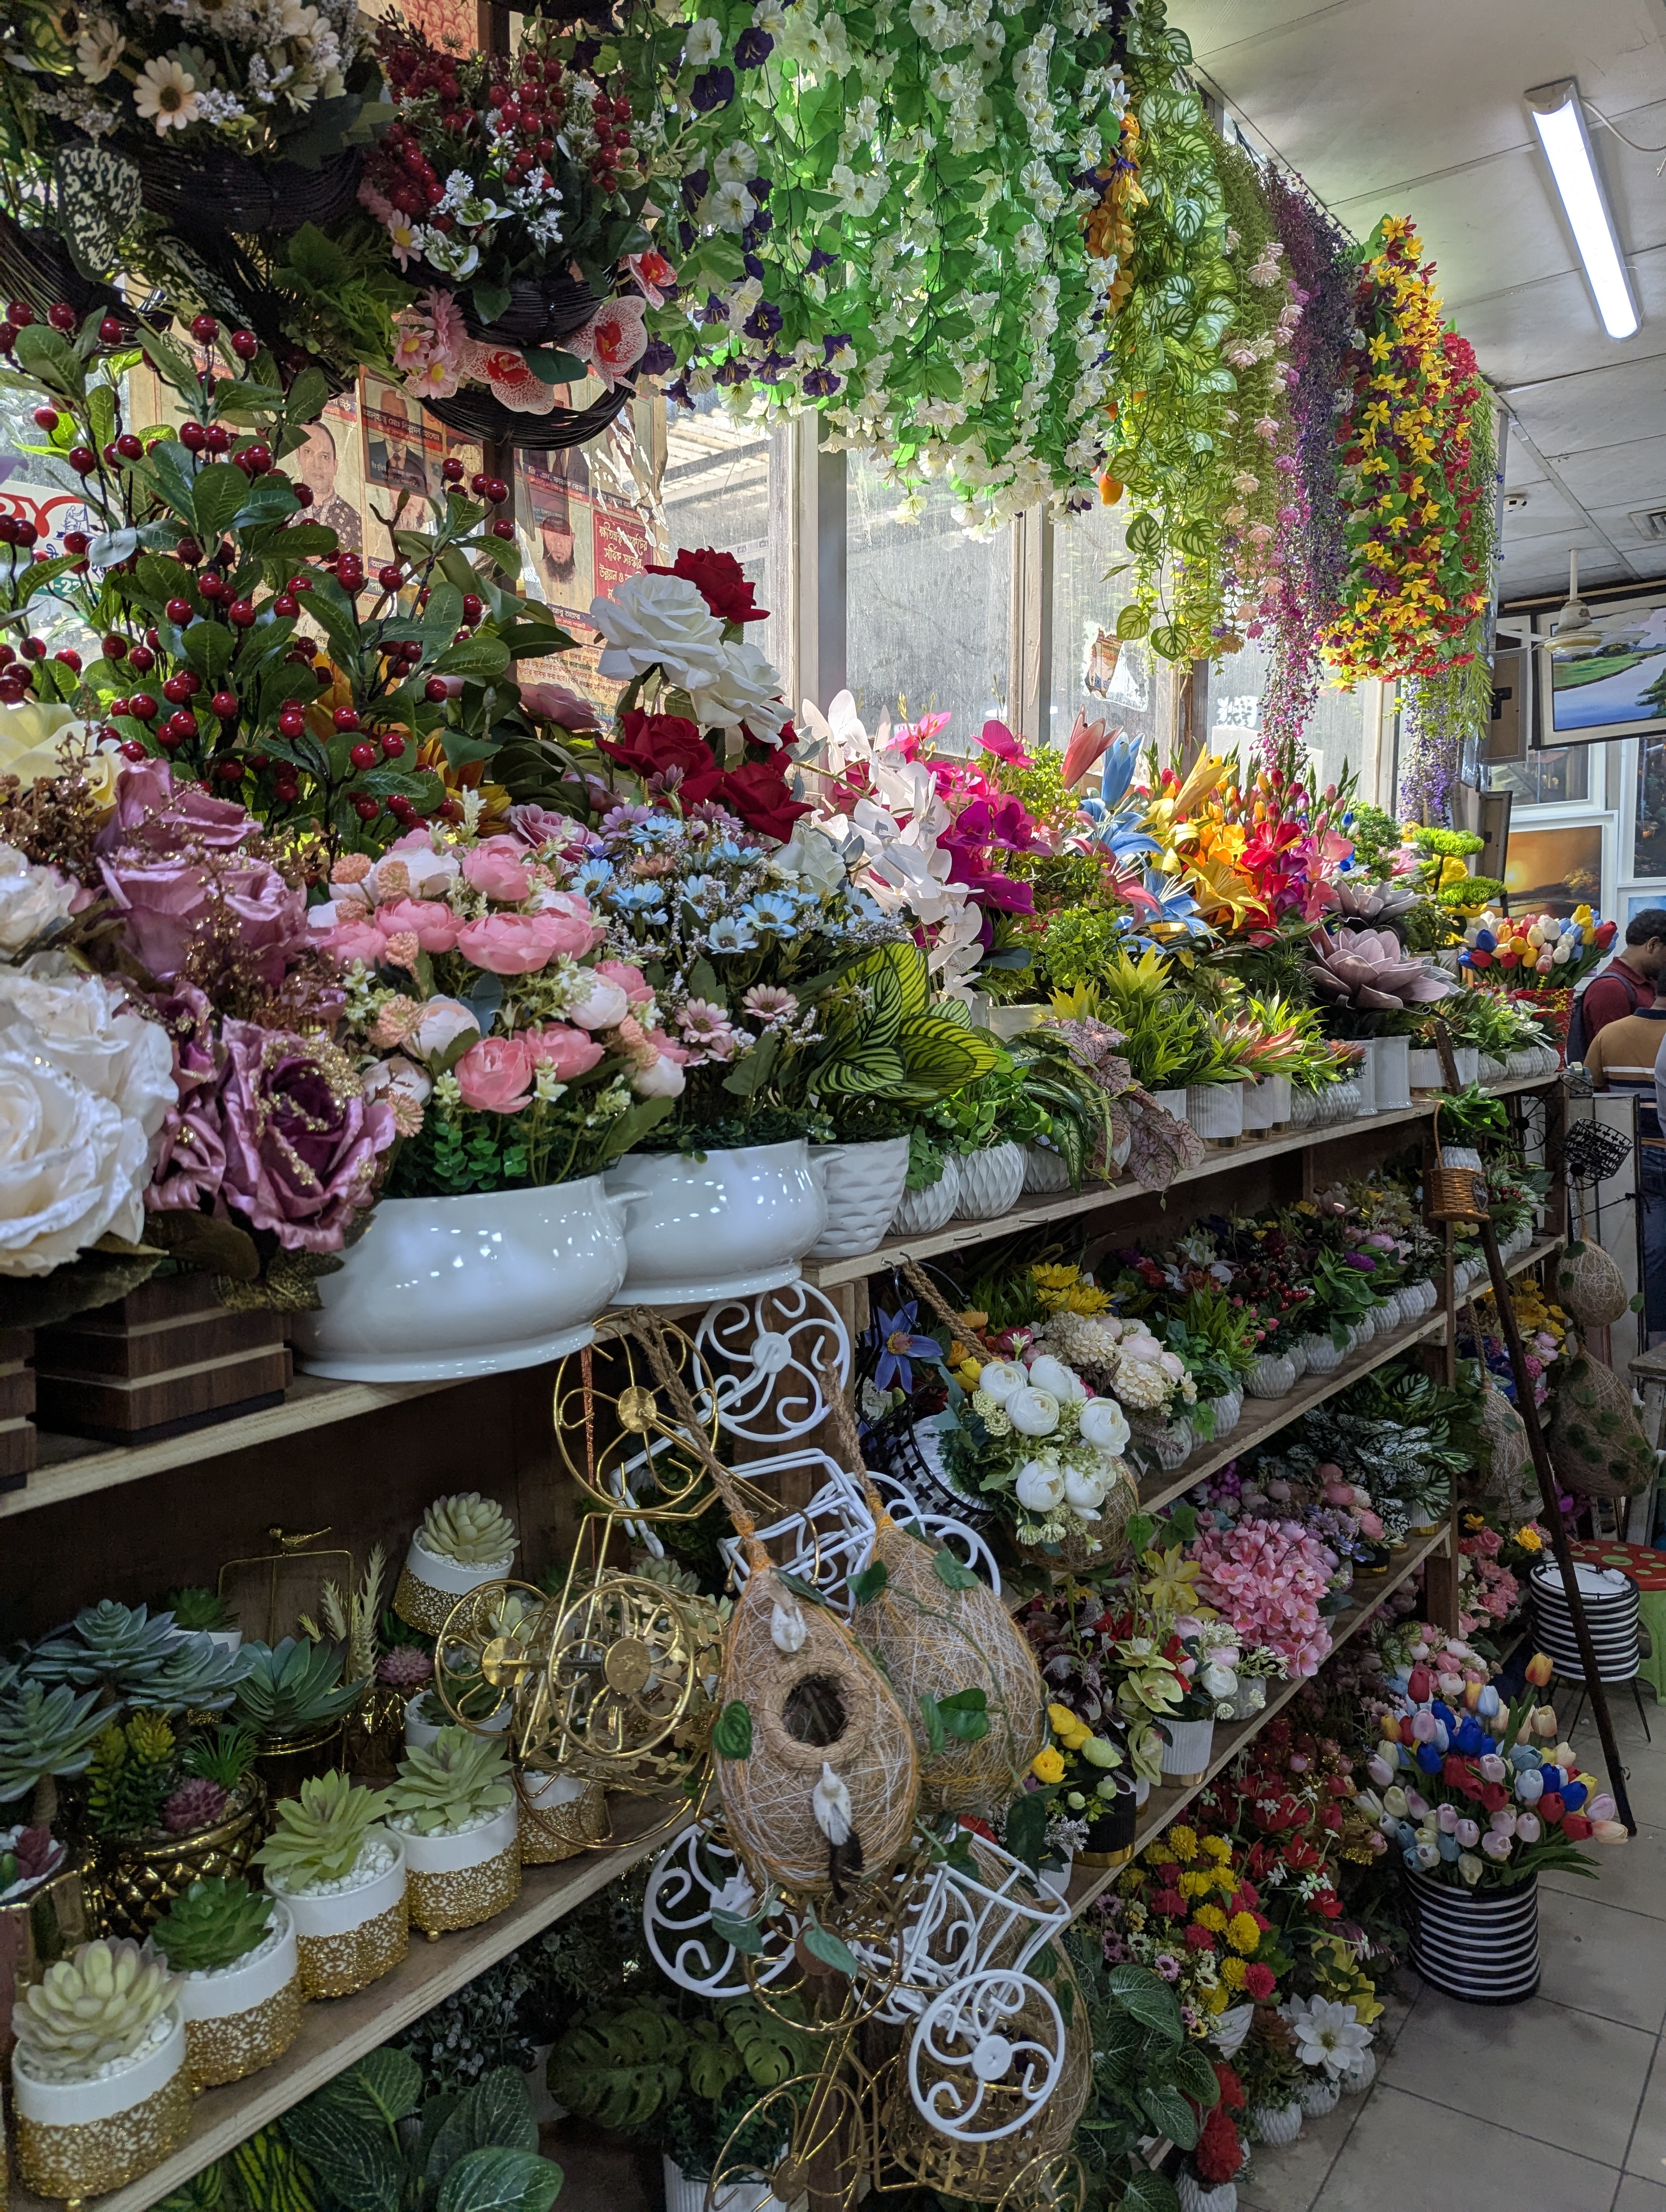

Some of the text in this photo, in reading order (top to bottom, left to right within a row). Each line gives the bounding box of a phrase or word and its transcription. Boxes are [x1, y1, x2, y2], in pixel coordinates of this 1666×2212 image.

[388, 418, 400, 427] মোঃ
[572, 483, 585, 493] রেজা
[604, 543, 622, 562] সার্বিক
[599, 563, 617, 581] উন্নয়ন
[618, 573, 624, 583] ও
[552, 607, 580, 620] আবু তাহের
